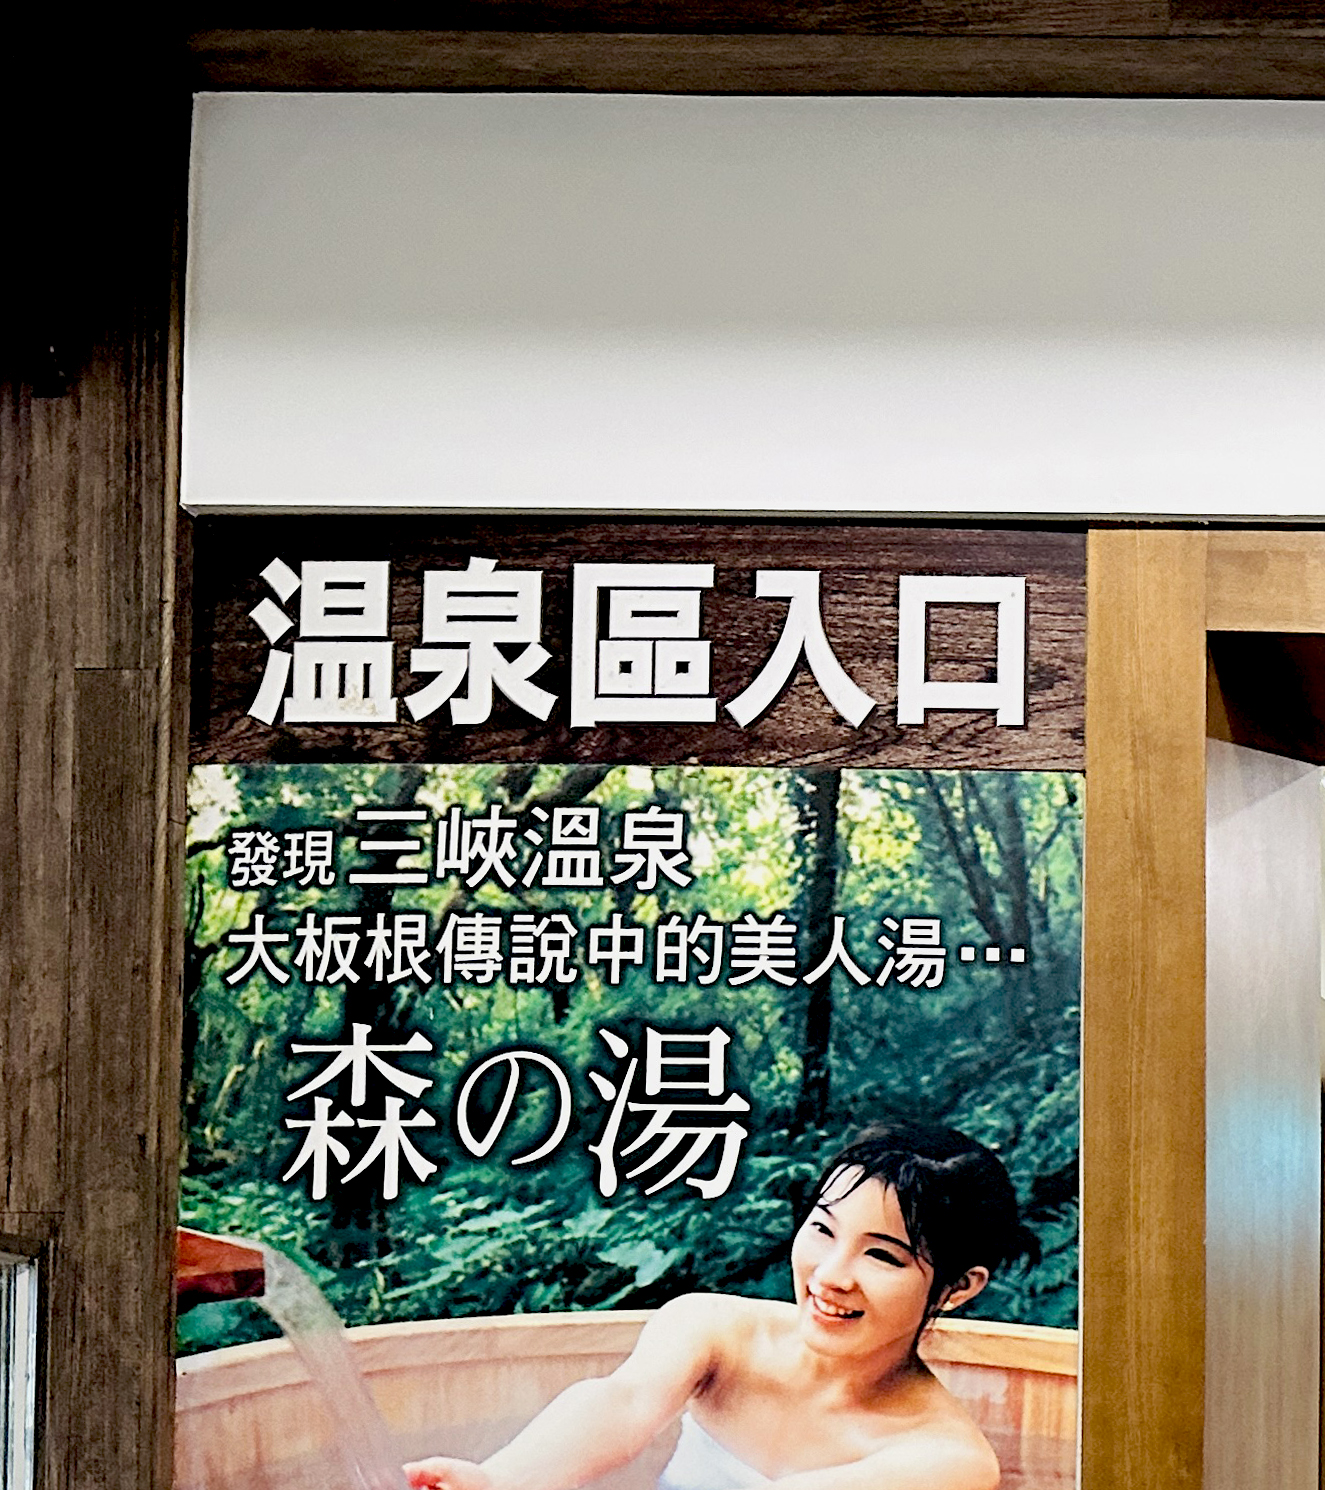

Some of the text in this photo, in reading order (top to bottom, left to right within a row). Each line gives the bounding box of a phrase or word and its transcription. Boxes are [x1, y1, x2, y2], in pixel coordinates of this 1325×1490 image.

[227, 804, 692, 890] 發現 三峽溫泉
[282, 1021, 752, 1201] 森の湯
